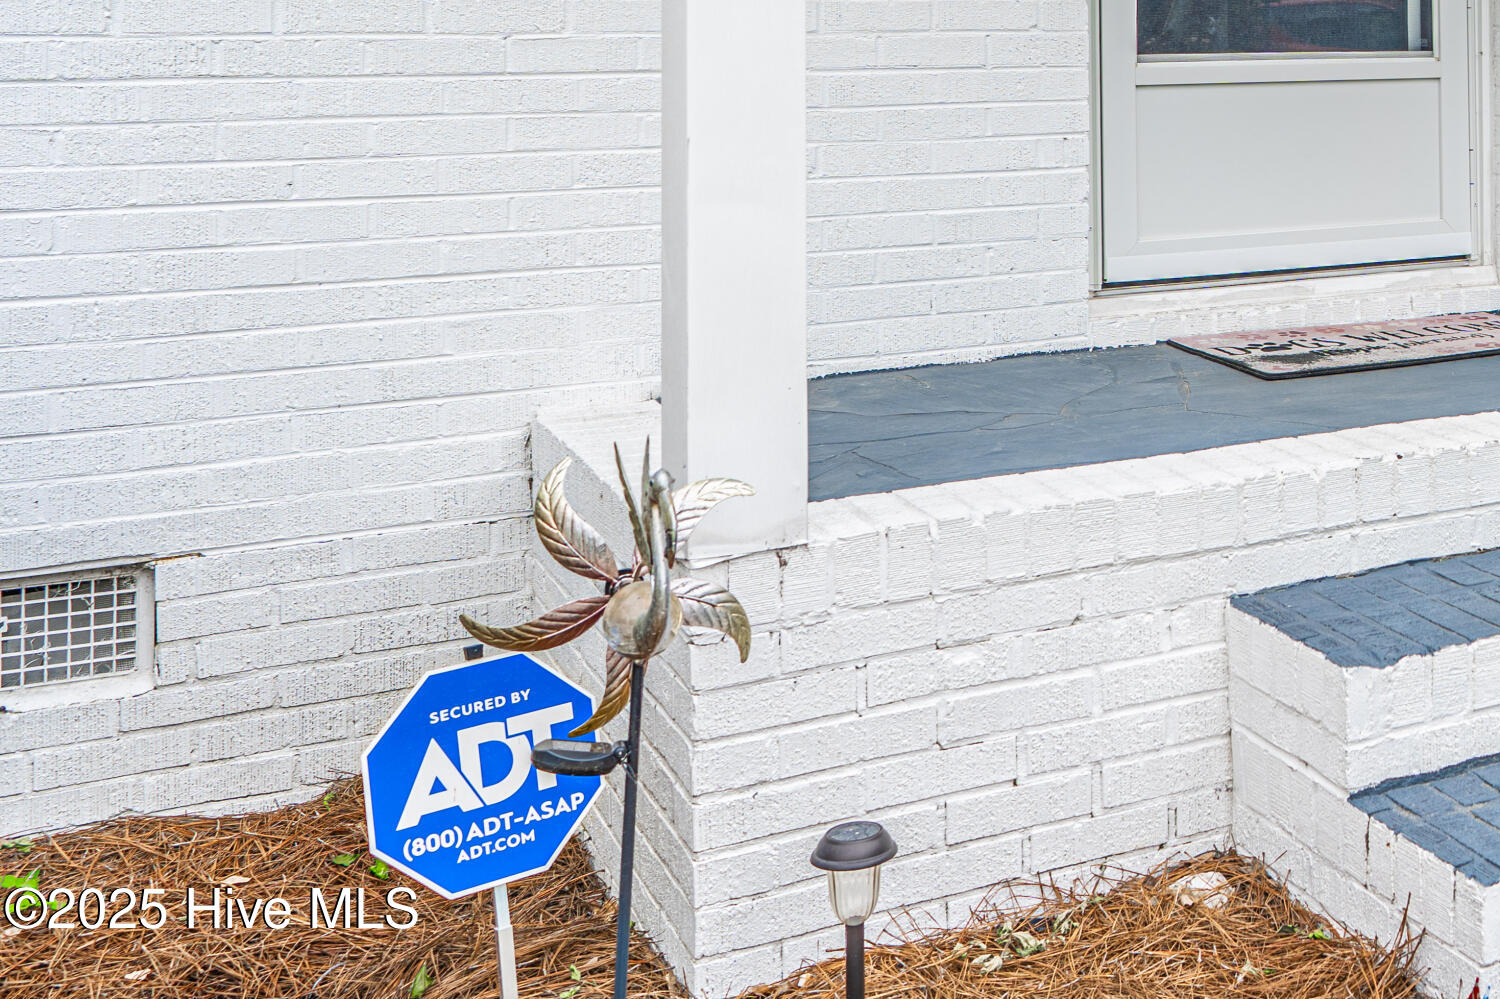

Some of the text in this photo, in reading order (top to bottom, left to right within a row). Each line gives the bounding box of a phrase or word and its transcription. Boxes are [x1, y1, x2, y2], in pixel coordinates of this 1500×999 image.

[429, 688, 530, 724] SECURED BY
[395, 701, 574, 832] ADT
[403, 792, 585, 862] (800) ADT-ASAP
[456, 829, 536, 864] ADT.COM
